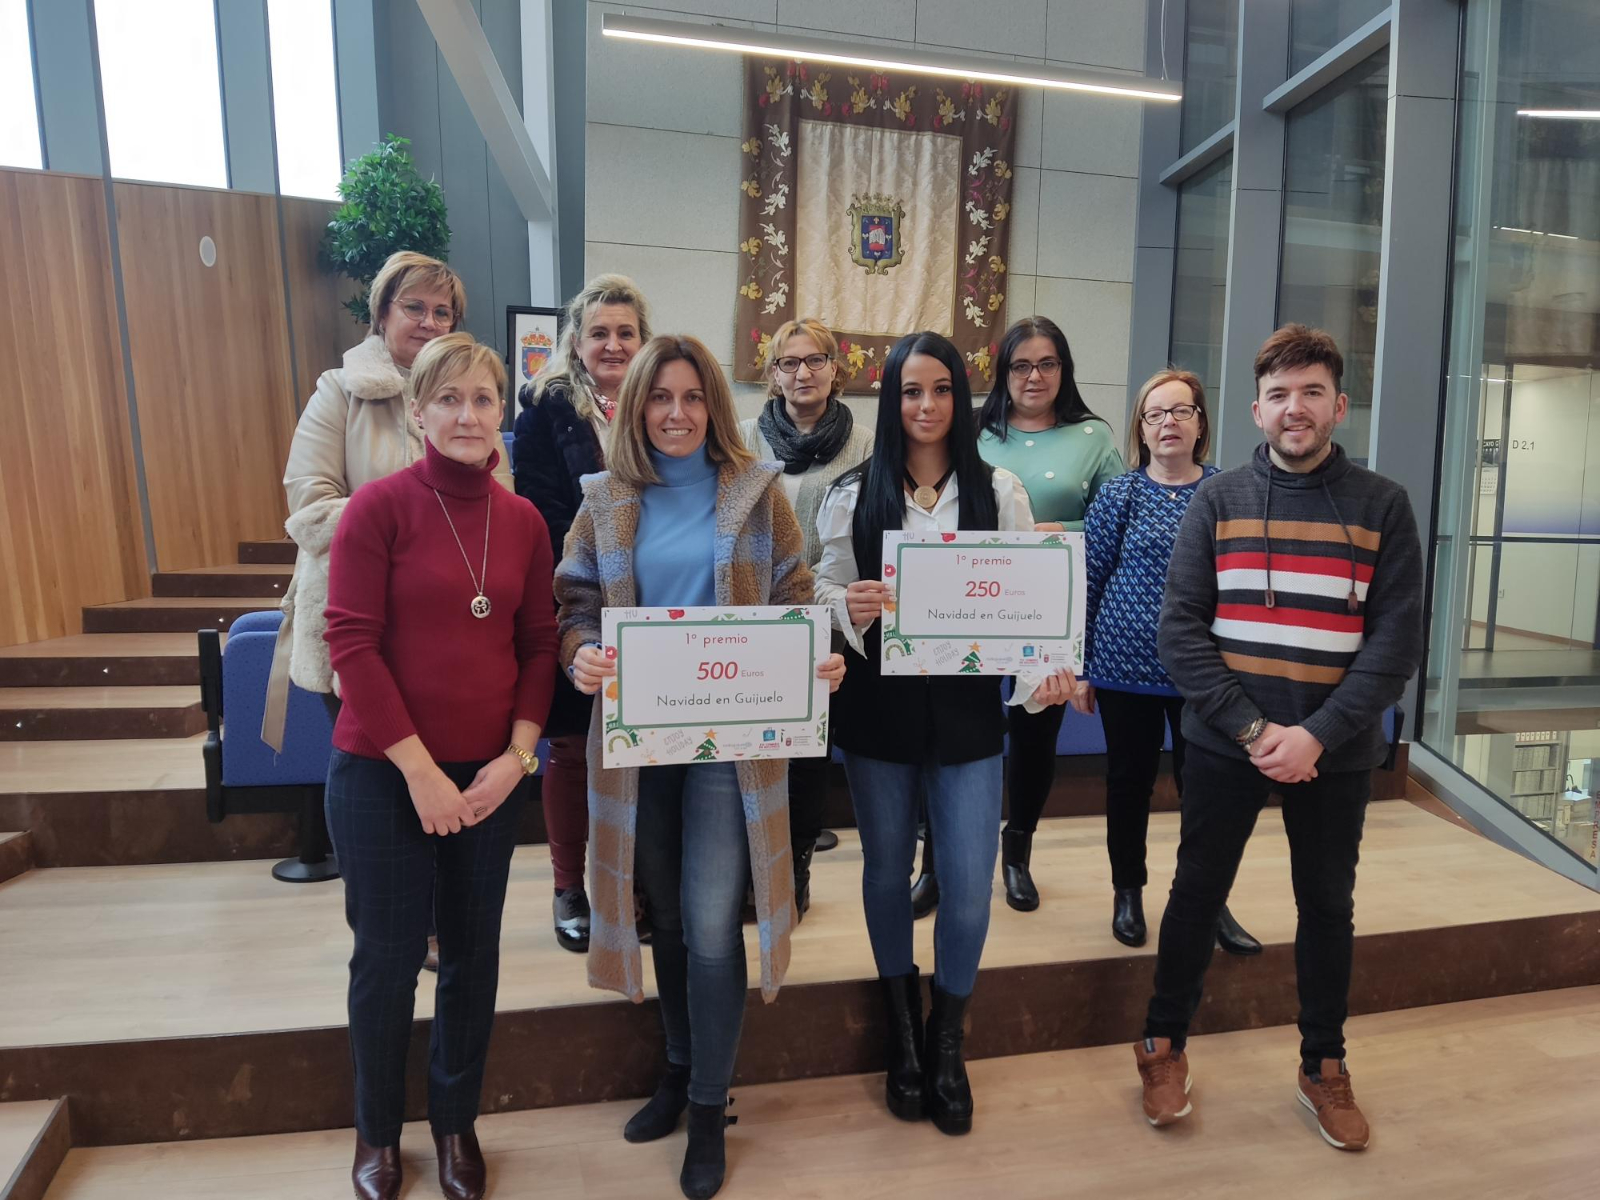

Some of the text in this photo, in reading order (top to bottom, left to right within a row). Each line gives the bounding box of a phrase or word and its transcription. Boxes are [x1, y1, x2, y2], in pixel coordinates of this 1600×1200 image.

[1512, 439, 1535, 451] D 2.1
[971, 555, 1012, 569] premio
[964, 580, 1026, 598] 250 Euros
[927, 608, 1043, 622] Navidad en Guijuelo
[703, 633, 748, 648] premio
[696, 660, 765, 681] 500 Euros
[656, 690, 784, 707] Navidad en Guijuelo
